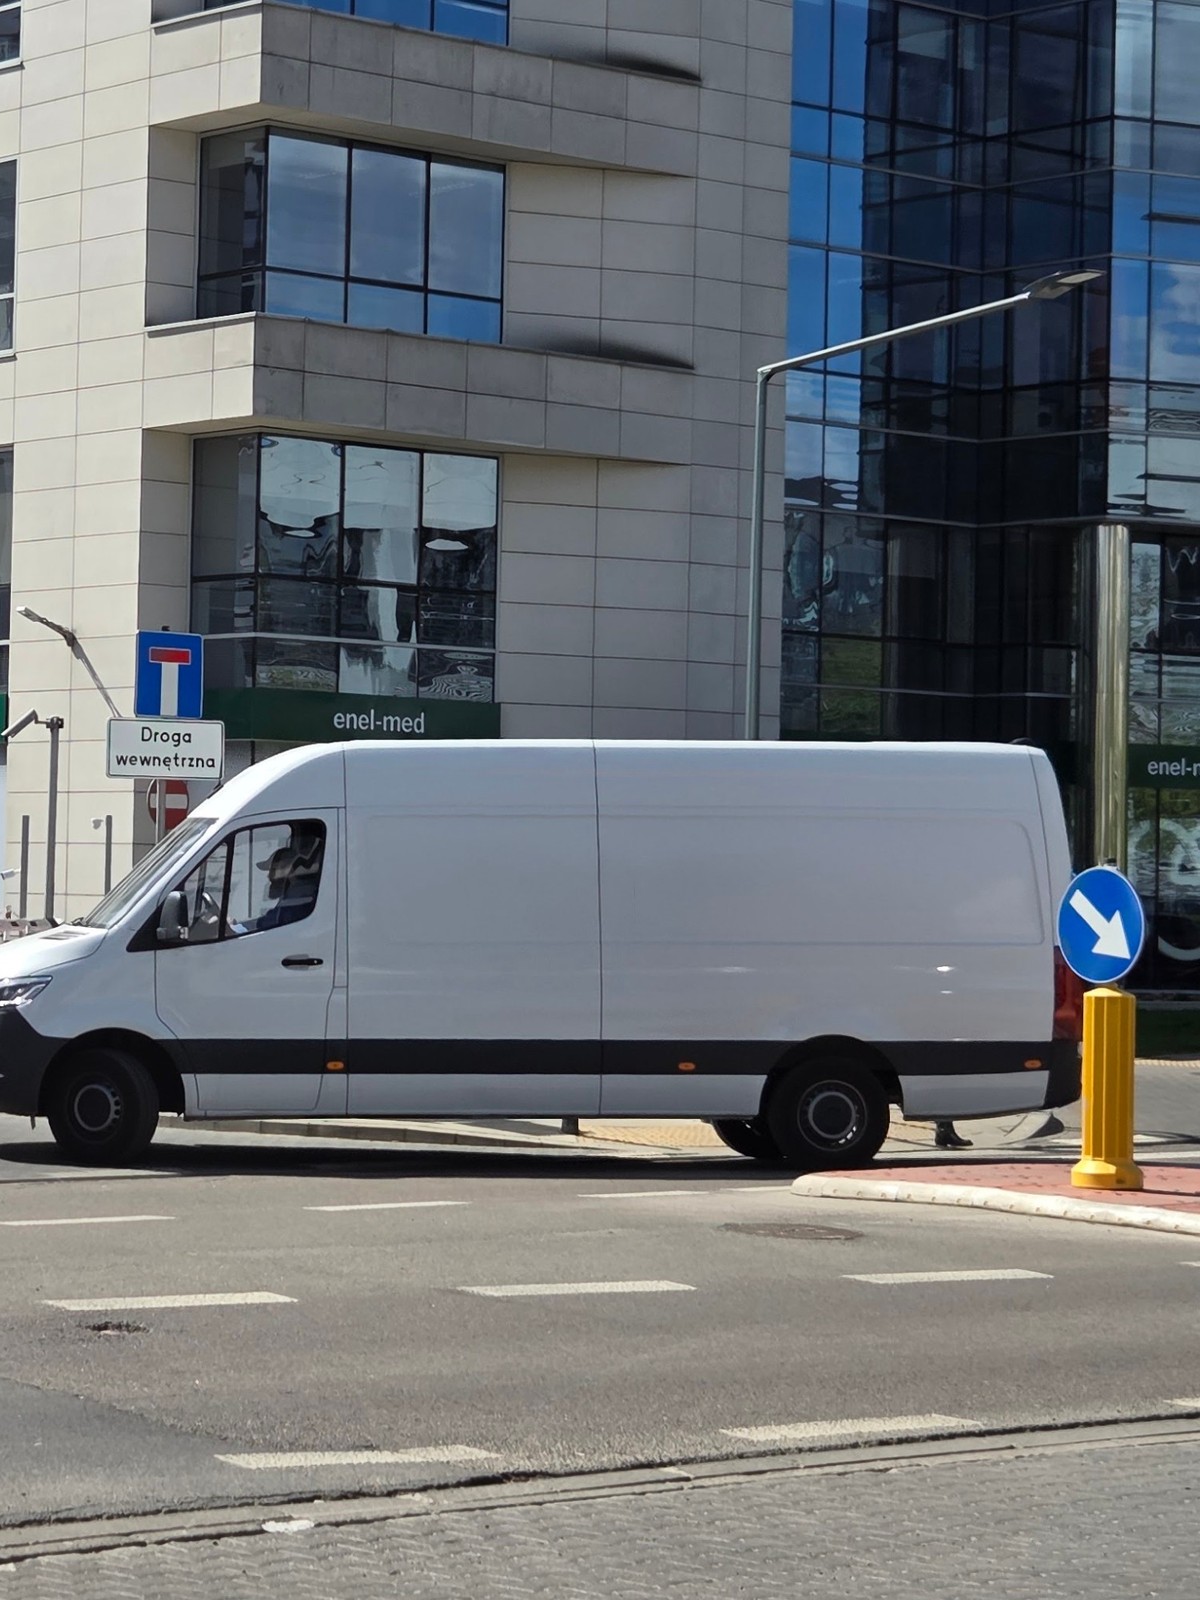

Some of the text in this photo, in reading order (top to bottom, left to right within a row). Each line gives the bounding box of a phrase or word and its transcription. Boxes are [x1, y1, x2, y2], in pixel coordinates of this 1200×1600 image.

[333, 708, 425, 734] enel-med
[141, 726, 192, 747] Droga
[116, 753, 216, 771] wewnętrzna
